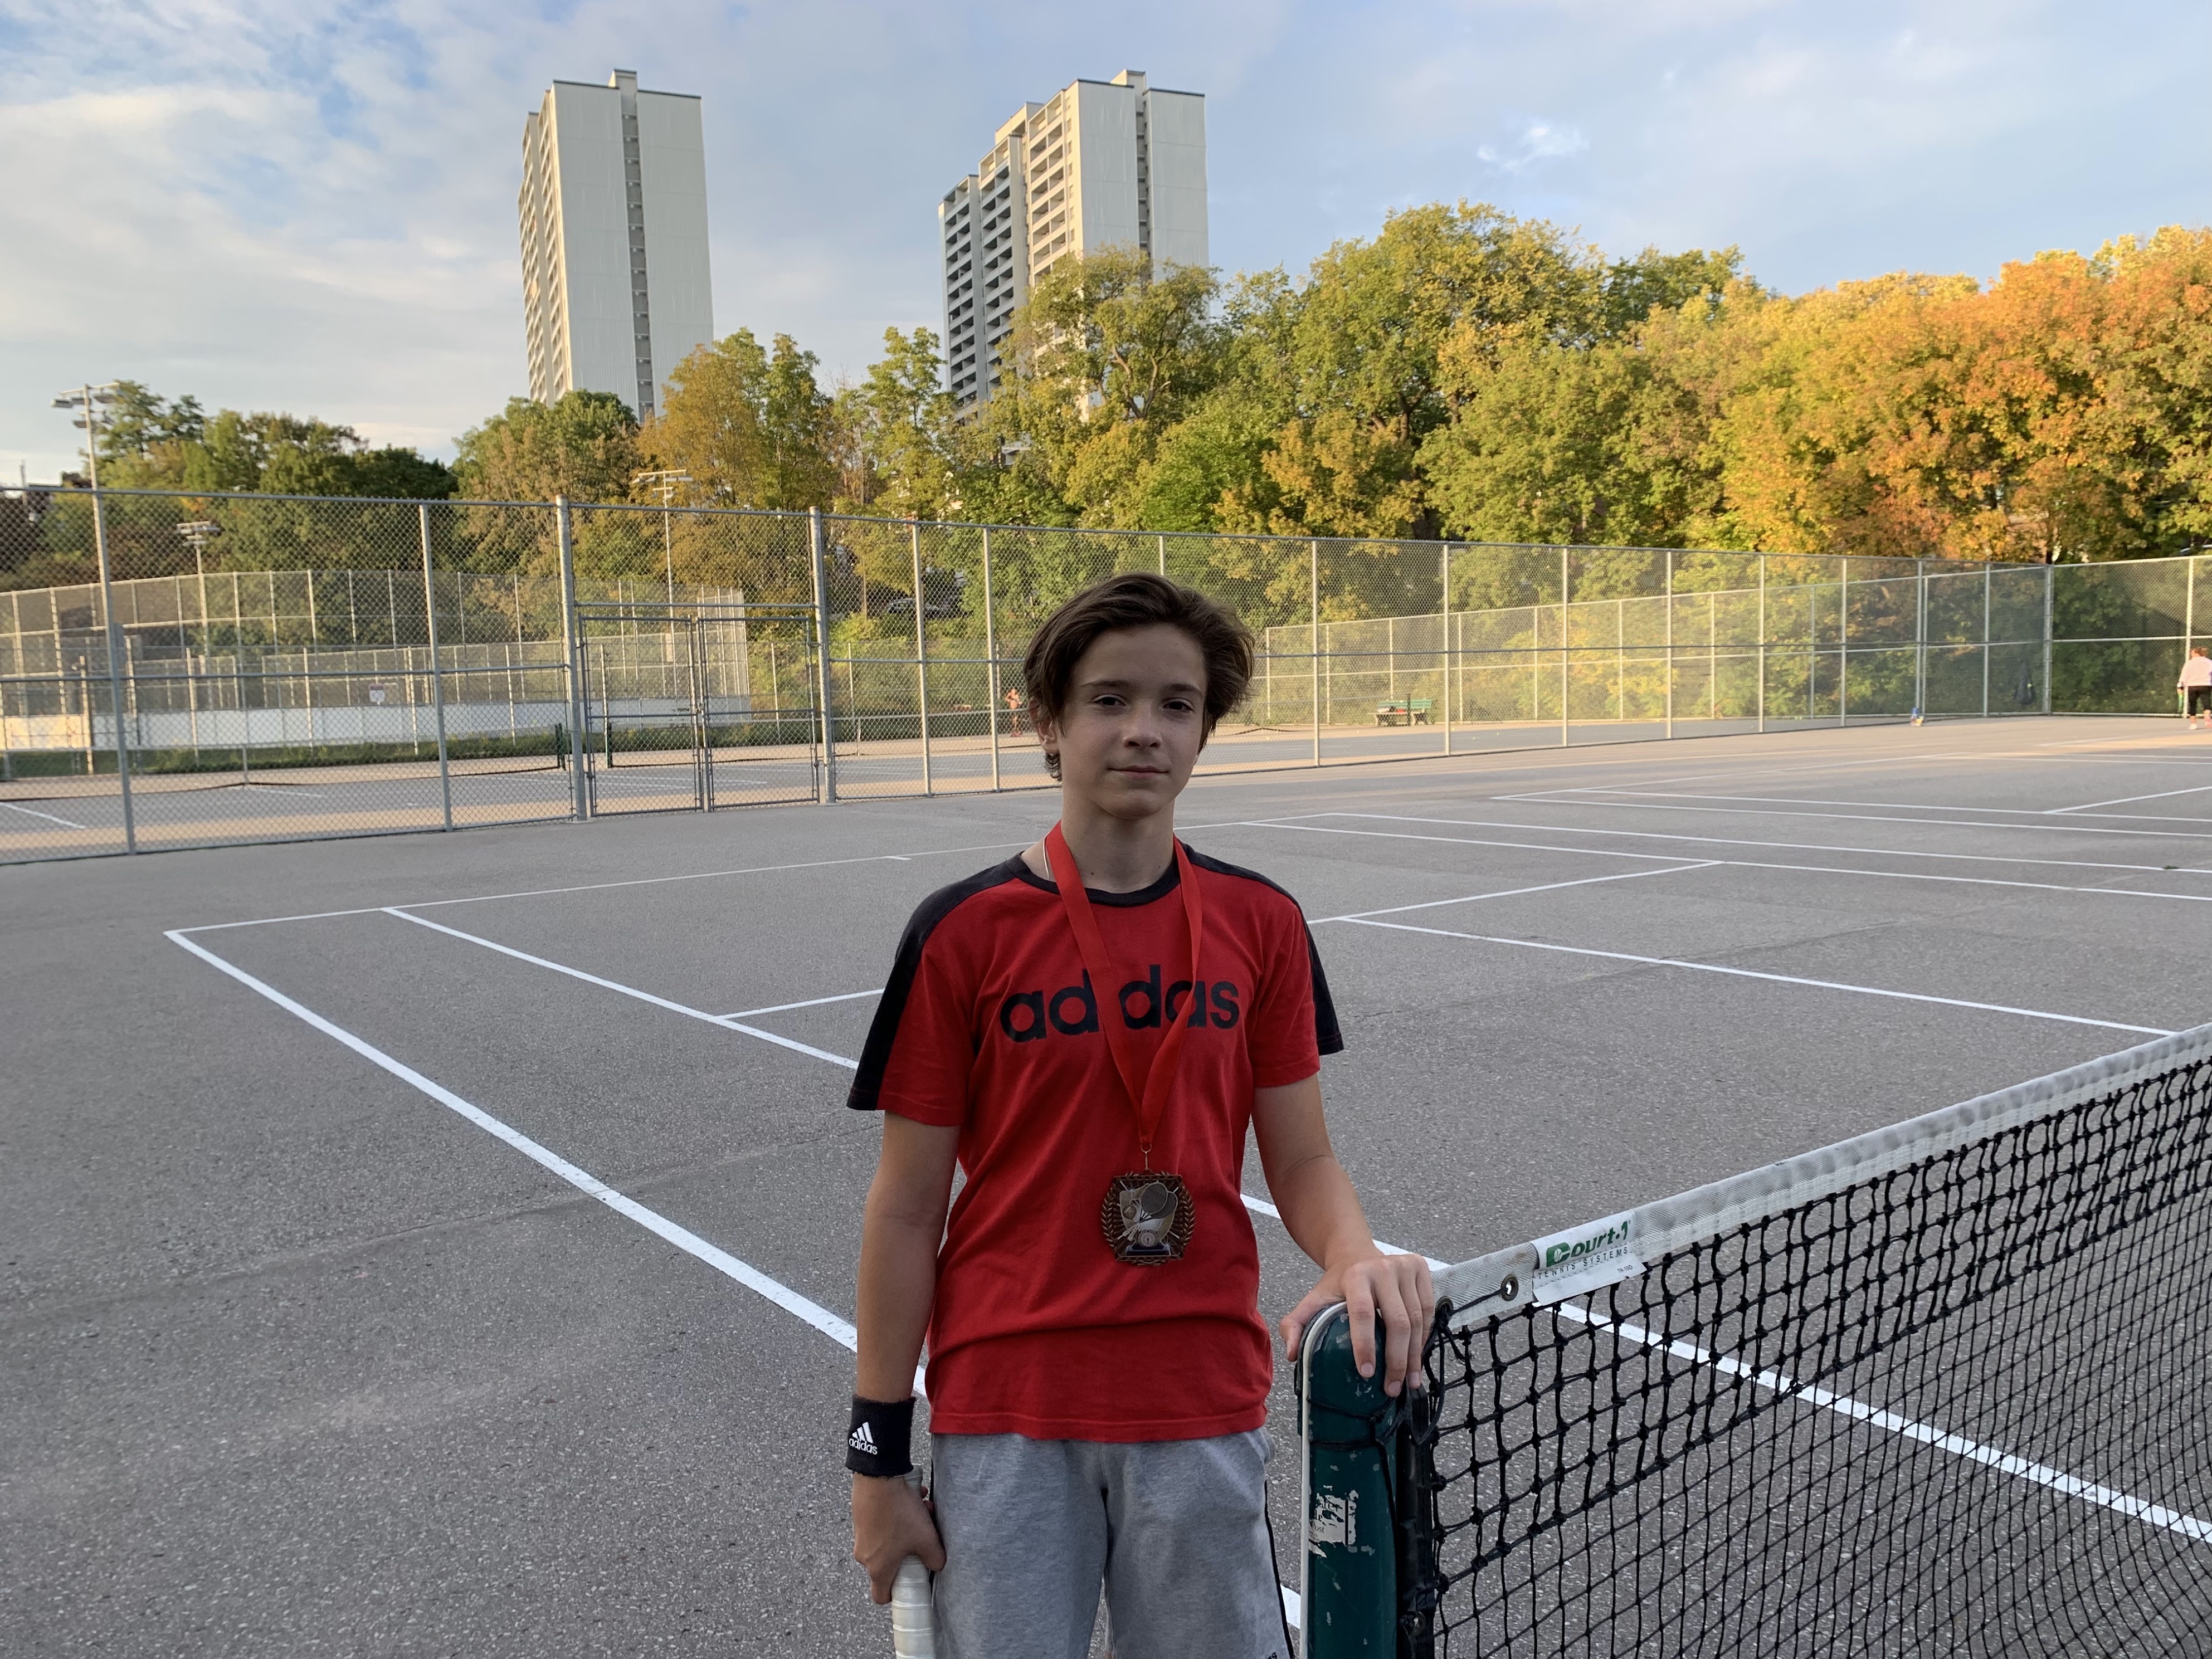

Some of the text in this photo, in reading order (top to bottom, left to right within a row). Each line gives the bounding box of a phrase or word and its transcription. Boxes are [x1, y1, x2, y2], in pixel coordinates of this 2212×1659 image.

[1000, 964, 1239, 1043] addas
[1538, 1247, 1628, 1279] TENNIS SYSTEMS
[849, 1438, 878, 1455] adidas
